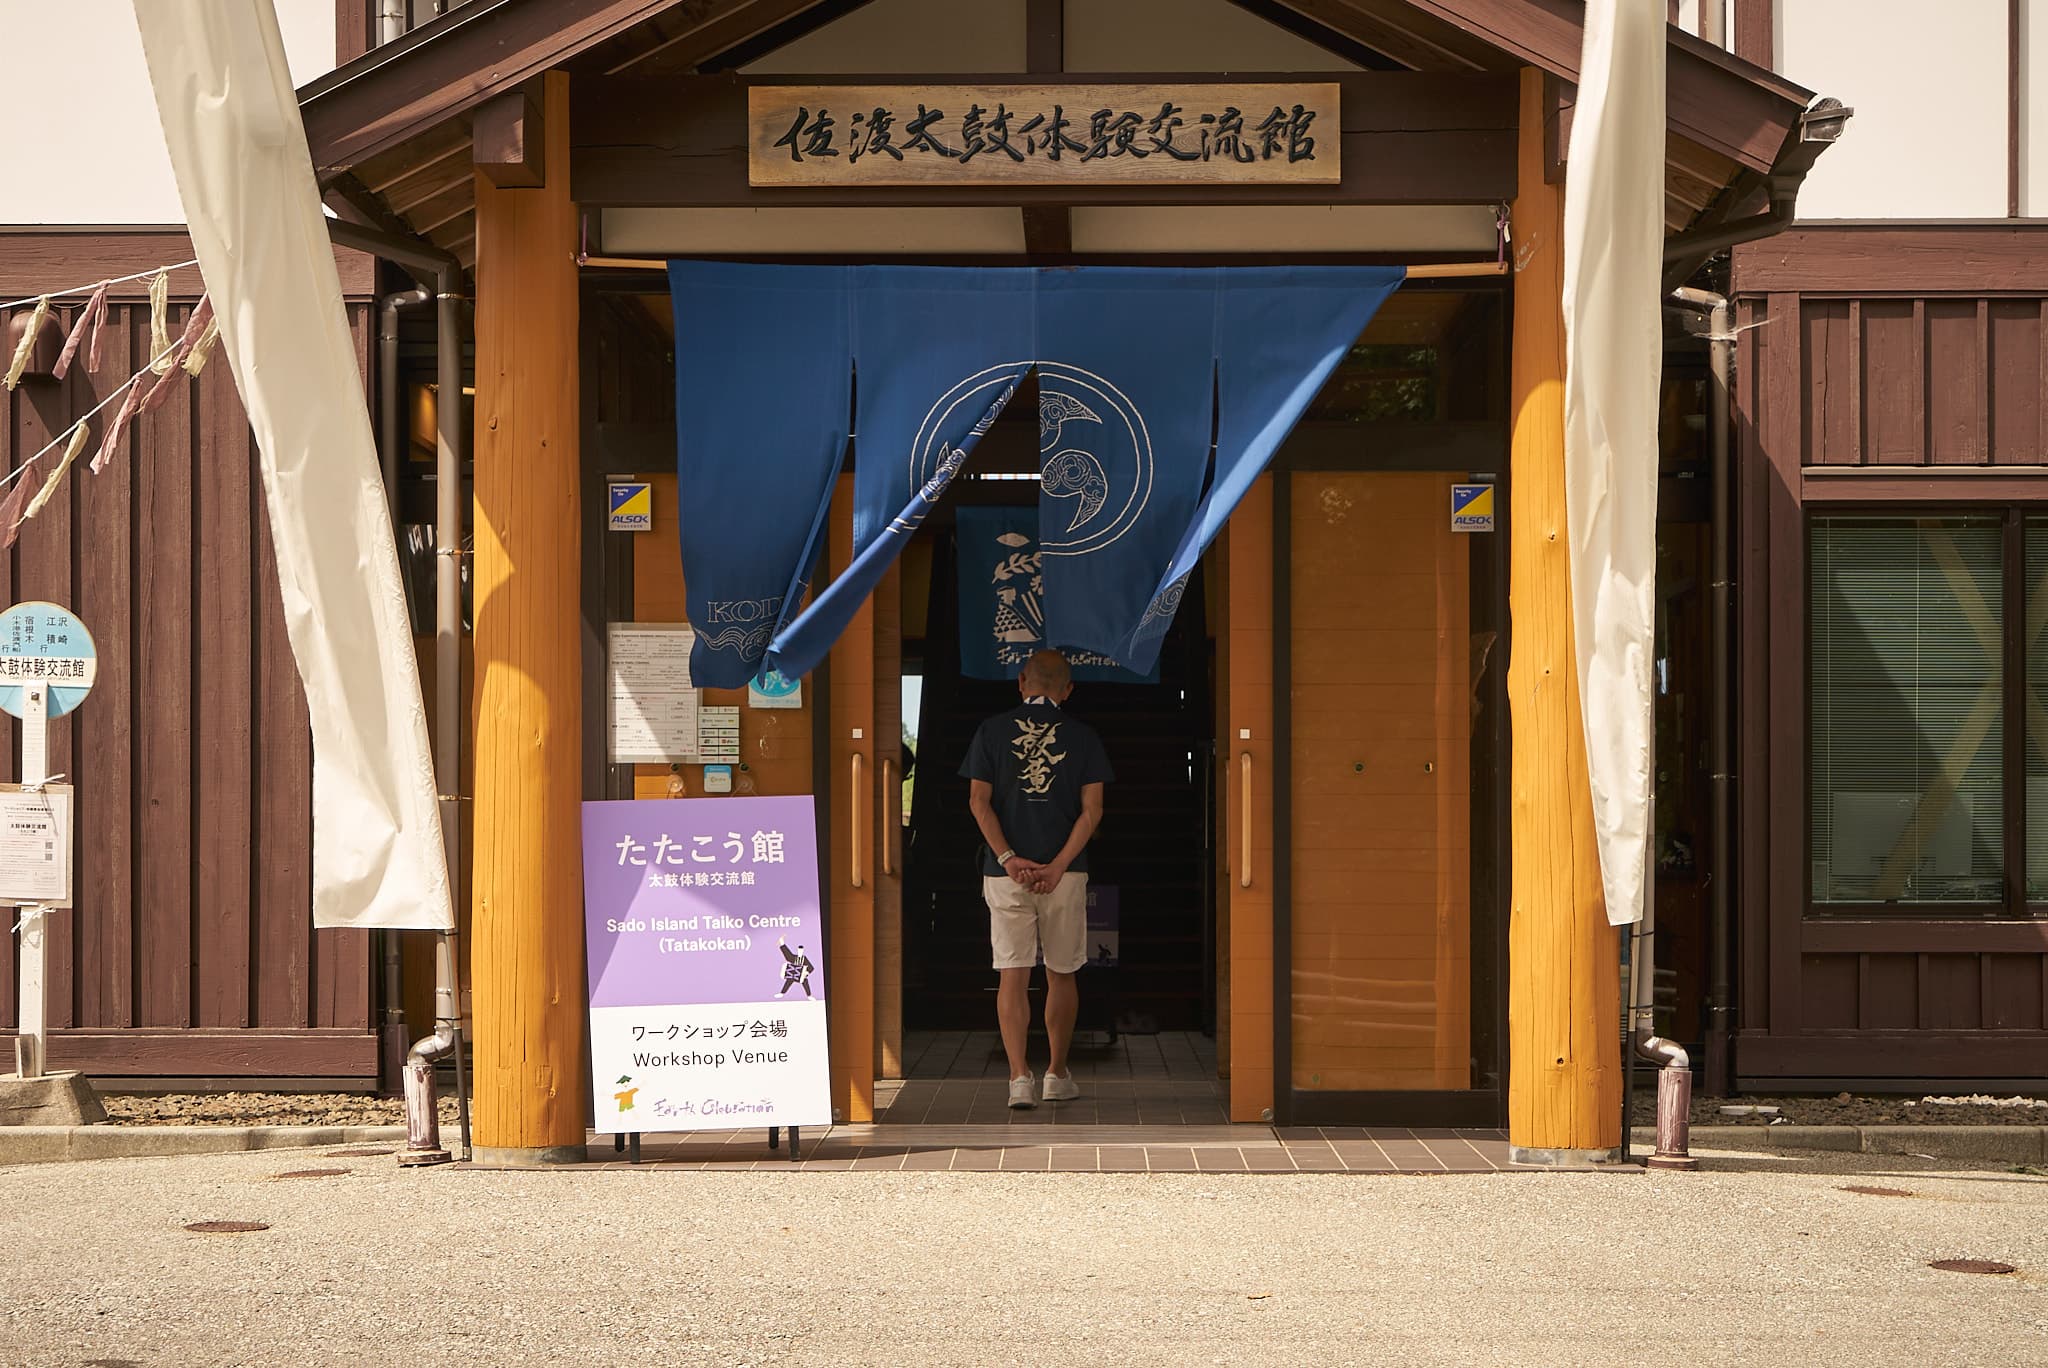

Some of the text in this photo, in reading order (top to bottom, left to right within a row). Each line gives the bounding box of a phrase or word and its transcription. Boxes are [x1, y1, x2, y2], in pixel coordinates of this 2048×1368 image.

[773, 103, 1316, 163] 佐渡太鼓体験交流館
[611, 515, 649, 524] ALSOK
[1455, 516, 1491, 524] ALSOK
[707, 596, 785, 624] KOD
[615, 830, 785, 866] たたこう館
[648, 871, 755, 888] 太鼓体験交流館
[606, 913, 801, 933] Sado Island Taiko Centre
[658, 934, 752, 953] (Tatakokan)
[632, 1019, 788, 1041] ワークショップ会場
[633, 1049, 789, 1068] Workshop Venue
